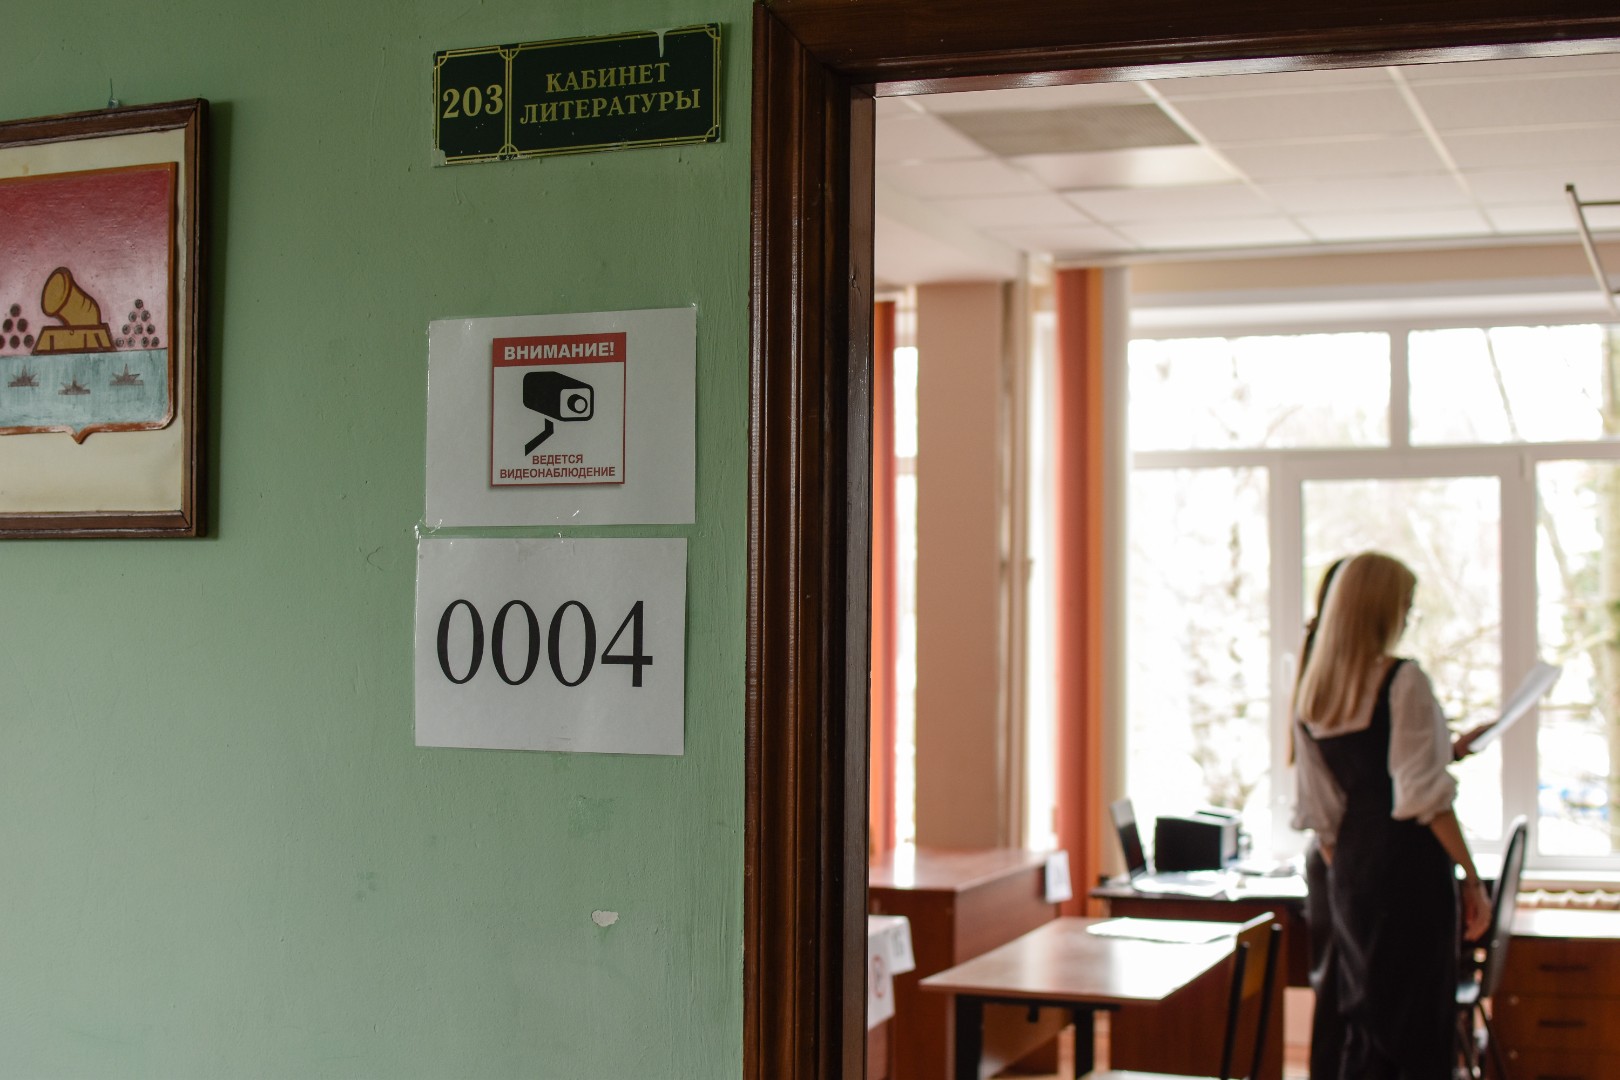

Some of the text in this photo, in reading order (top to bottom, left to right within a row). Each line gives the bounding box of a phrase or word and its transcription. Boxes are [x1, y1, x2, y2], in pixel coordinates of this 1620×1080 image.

[545, 62, 670, 93] КАБИНЕТ
[443, 84, 503, 118] 203
[520, 89, 701, 124] ЛИТЕРАТУРЫ
[504, 342, 615, 360] ВНИМАНИЕ!
[500, 466, 616, 480] ВИДЕОНАБЛЮДЕНИЕ
[532, 454, 583, 466] ВЕДЕТСЯ
[437, 599, 653, 687] 0004
